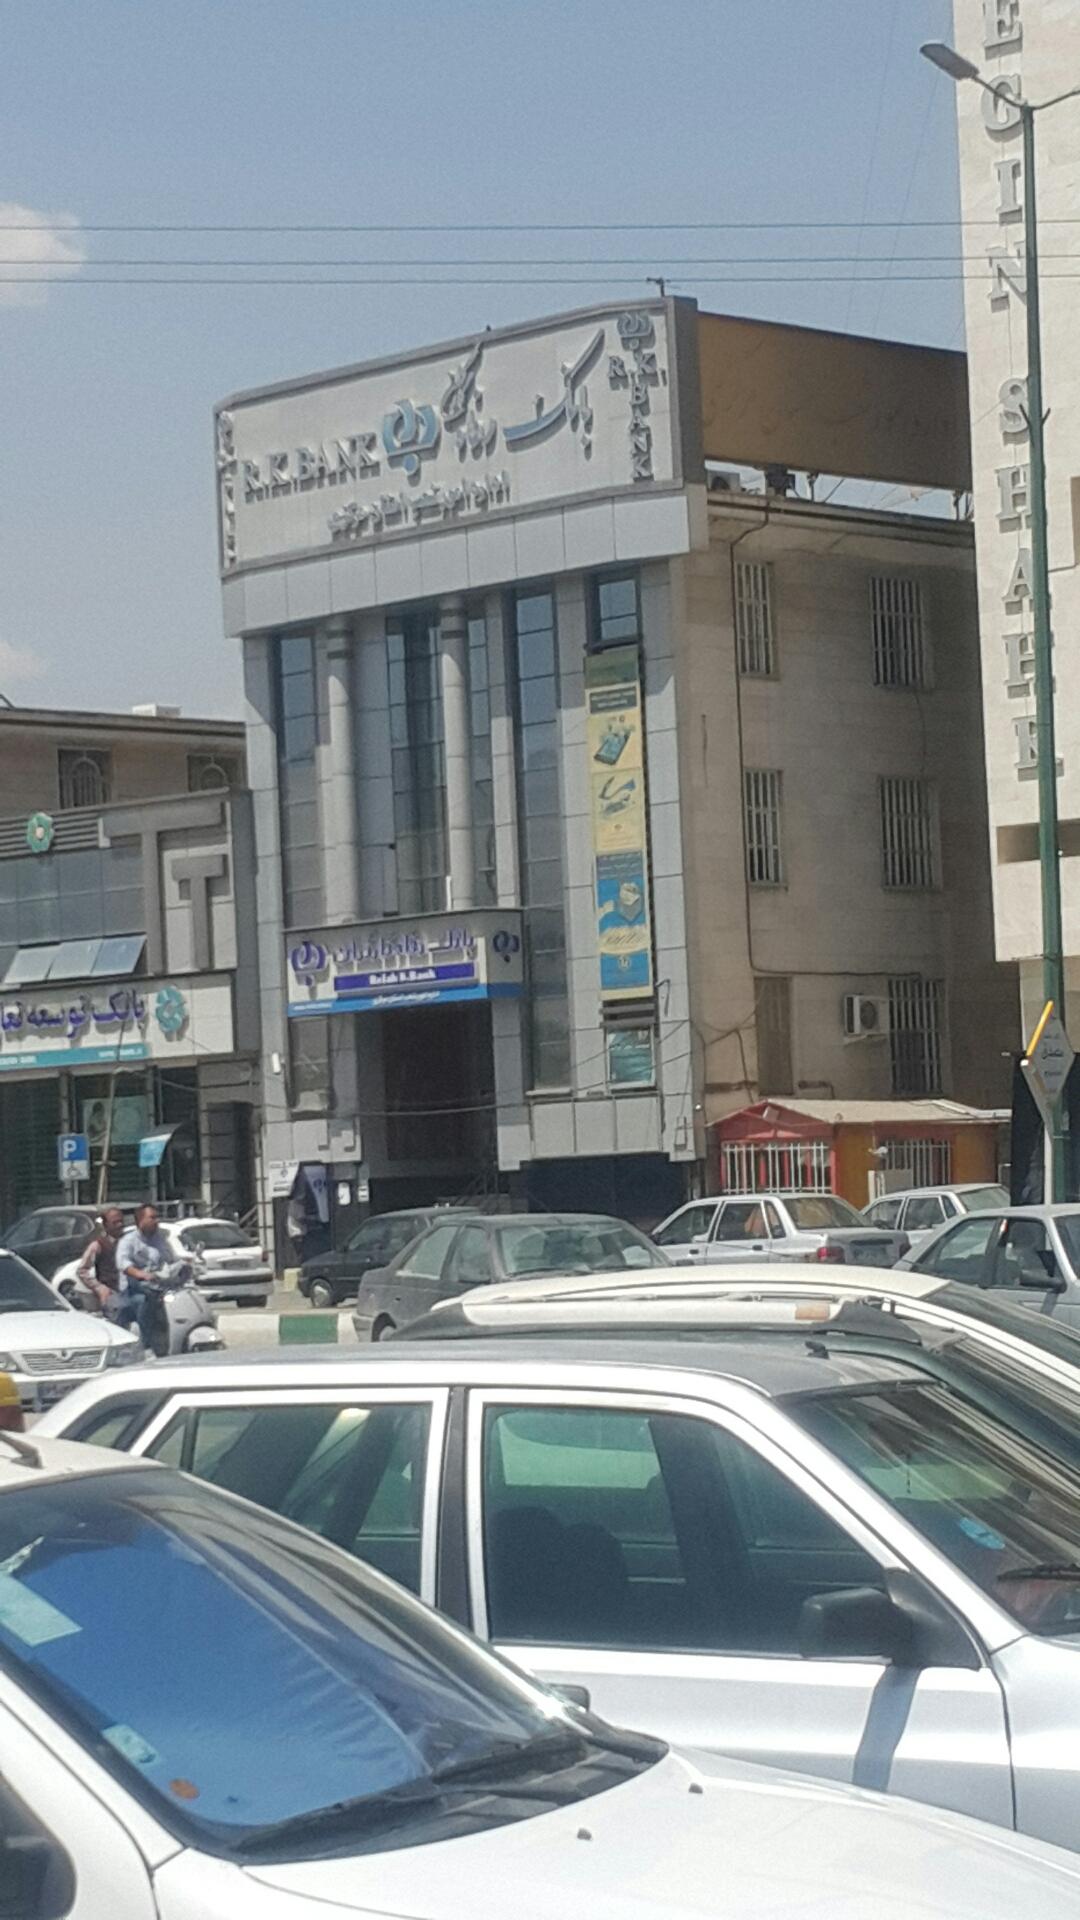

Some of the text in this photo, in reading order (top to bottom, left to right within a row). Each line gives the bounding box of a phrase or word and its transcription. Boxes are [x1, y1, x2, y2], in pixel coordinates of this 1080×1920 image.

[27, 994, 95, 1039] توسعه
[92, 987, 145, 1030] بانک
[63, 1139, 77, 1158] P
